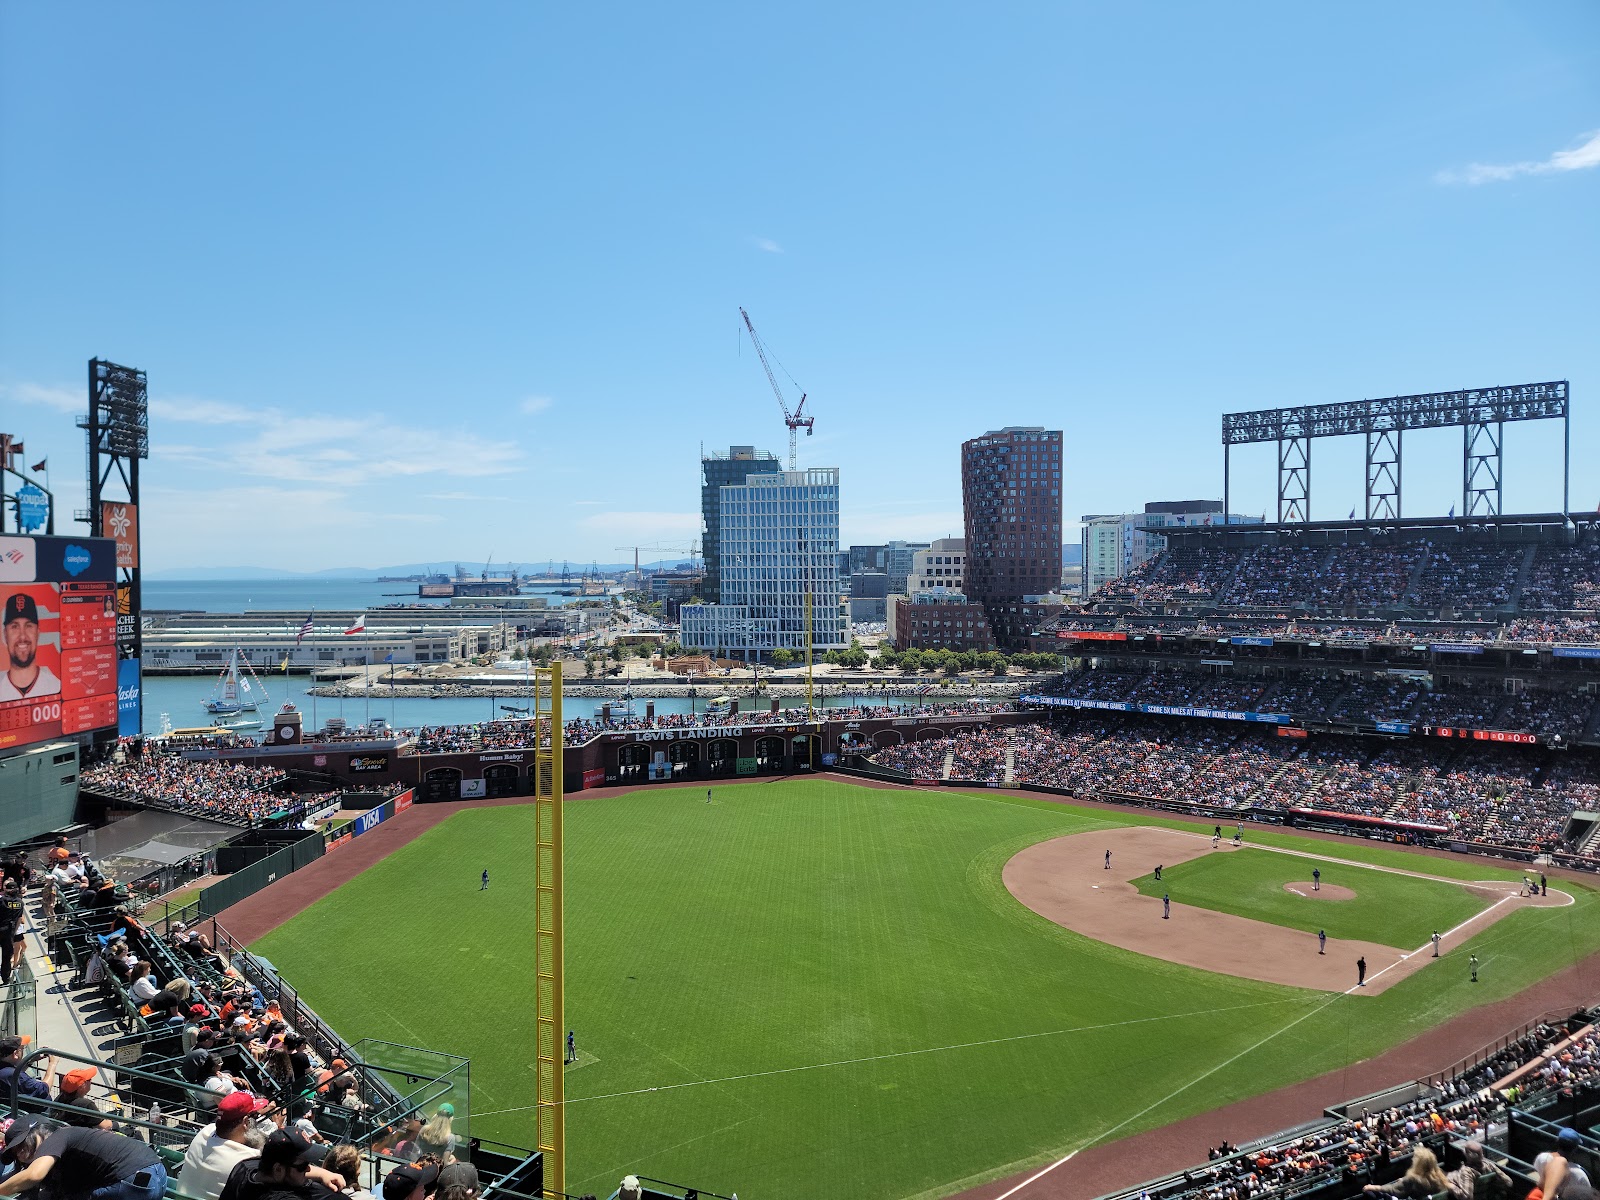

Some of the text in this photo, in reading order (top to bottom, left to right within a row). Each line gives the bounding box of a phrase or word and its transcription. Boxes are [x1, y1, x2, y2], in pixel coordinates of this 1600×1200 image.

[19, 494, 47, 507] coupa
[67, 556, 89, 564] salesforce
[1040, 696, 1054, 704] SCORE
[1148, 705, 1163, 713] SCORE
[1164, 706, 1170, 714] 5X
[1170, 707, 1186, 715] MILES
[1194, 708, 1212, 717] FRIDAY
[1212, 710, 1227, 718] HOME
[1228, 712, 1246, 720] GAMES
[680, 728, 743, 740] LANDING
[1422, 726, 1432, 736] T
[1442, 728, 1448, 736] 0
[1498, 732, 1504, 740] 0
[1514, 734, 1520, 742] 0
[1528, 735, 1536, 743] 0
[362, 757, 387, 767] Sports
[362, 809, 380, 832] VISA
